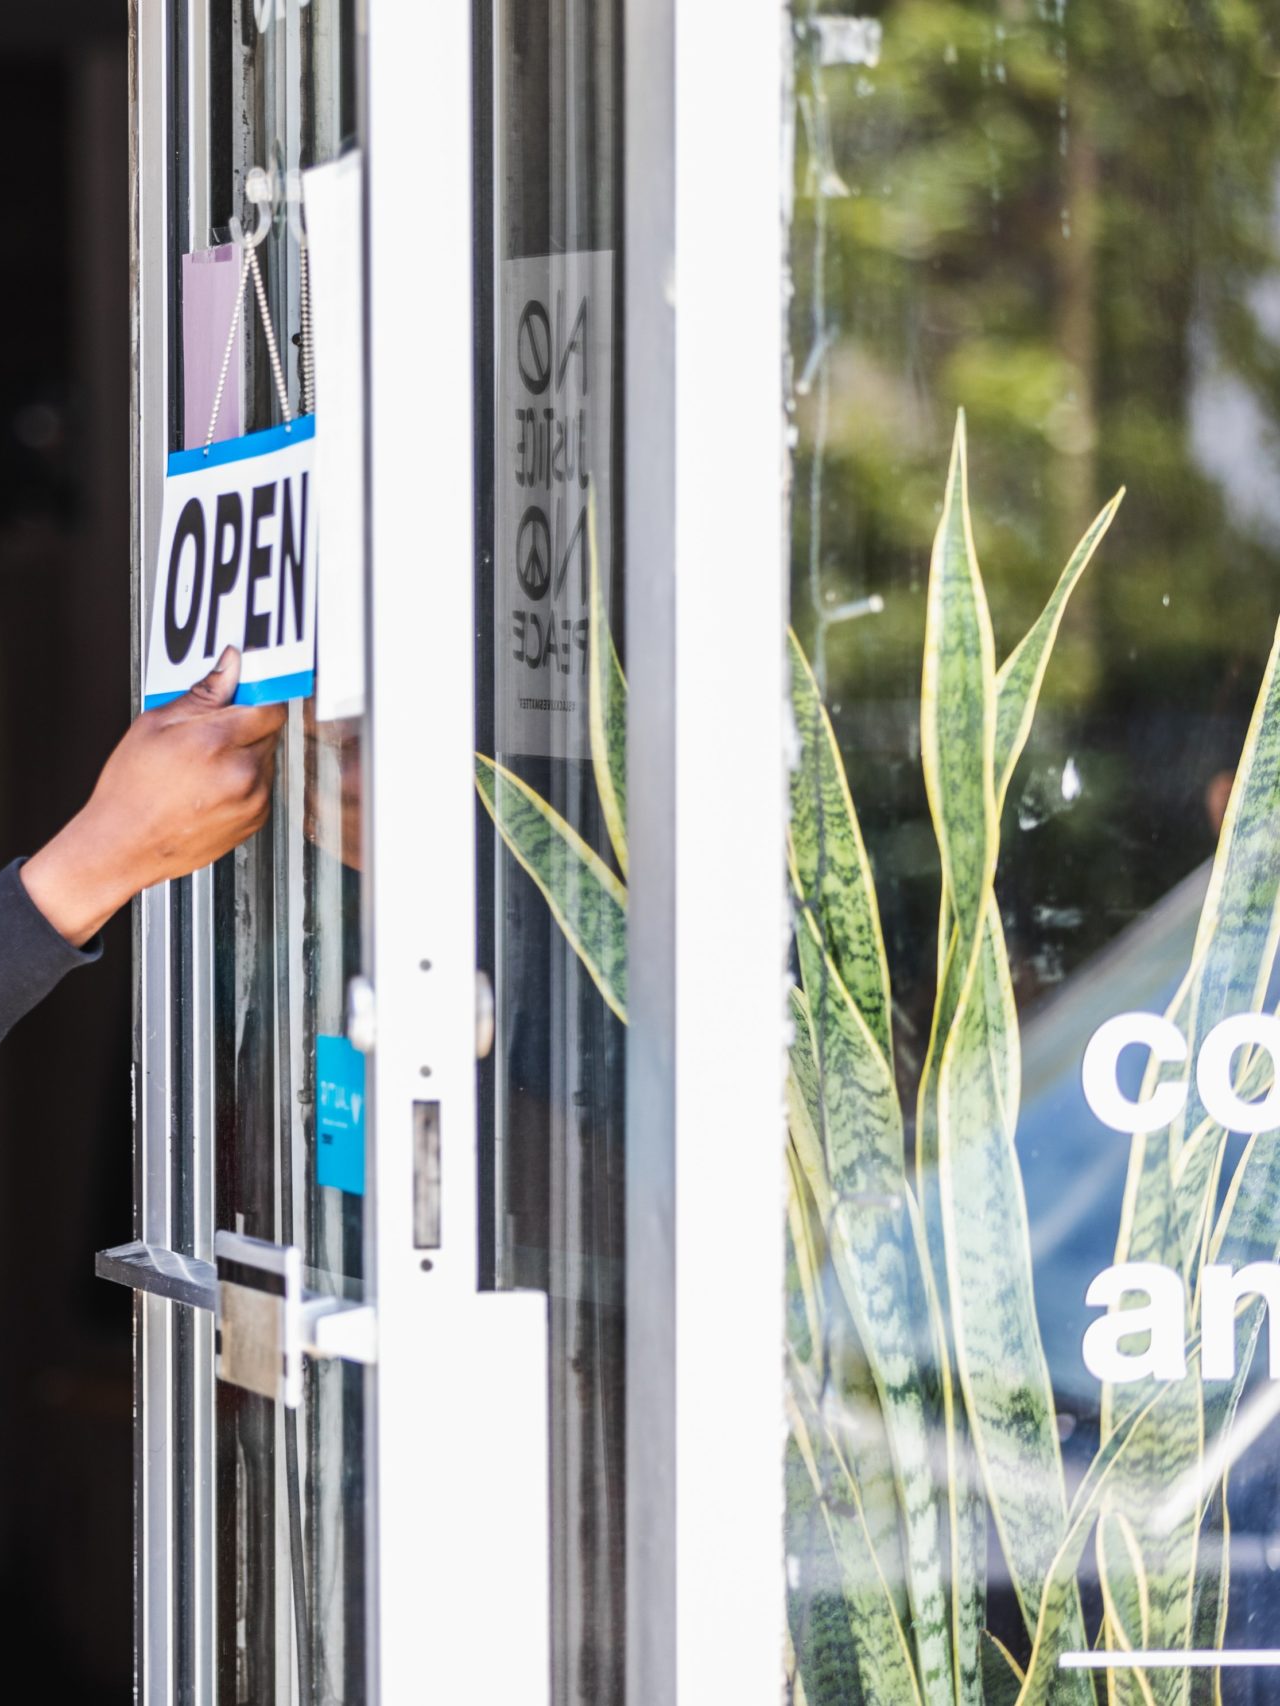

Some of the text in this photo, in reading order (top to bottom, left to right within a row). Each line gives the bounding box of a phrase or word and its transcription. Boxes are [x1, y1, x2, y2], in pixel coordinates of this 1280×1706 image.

[164, 470, 309, 666] OPEN
[1081, 1011, 1280, 1134] co
[1081, 1260, 1280, 1382] an
